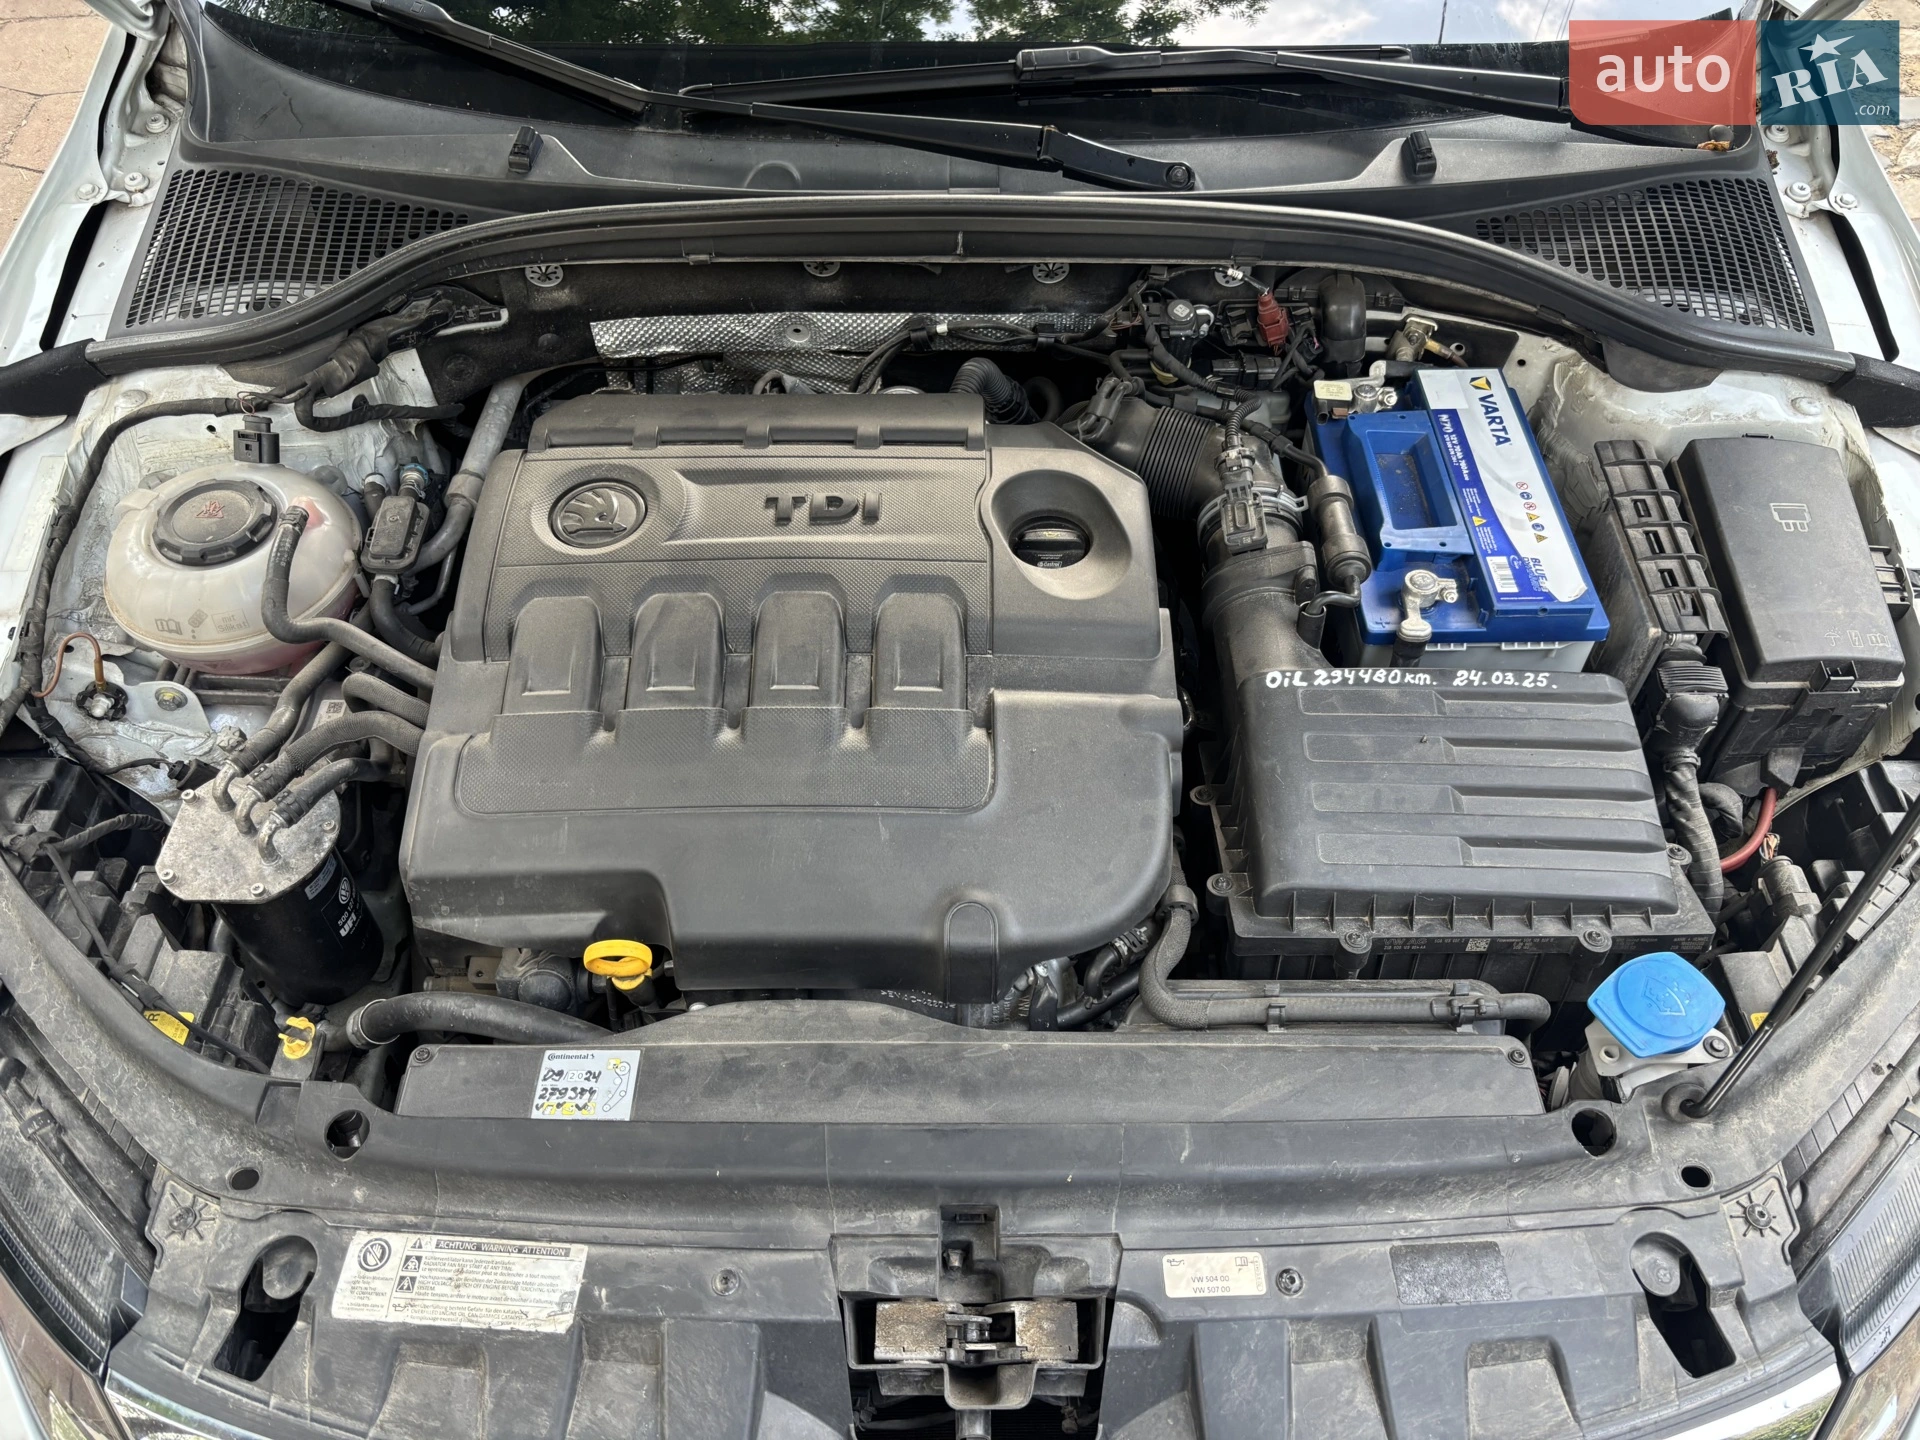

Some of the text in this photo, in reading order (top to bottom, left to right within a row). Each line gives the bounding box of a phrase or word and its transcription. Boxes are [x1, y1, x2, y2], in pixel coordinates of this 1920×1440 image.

[1437, 413, 1453, 434] N70
[1478, 393, 1512, 447] VARTA
[765, 492, 882, 525] TDI
[1531, 557, 1547, 582] BLUE
[221, 614, 236, 623] mit
[217, 620, 248, 633] Silikat
[547, 1052, 589, 1061] Continental
[438, 1241, 566, 1256] ACHTUNG WARNING ATTENTION
[1205, 1275, 1218, 1283] 504
[1220, 1285, 1231, 1293] 00
